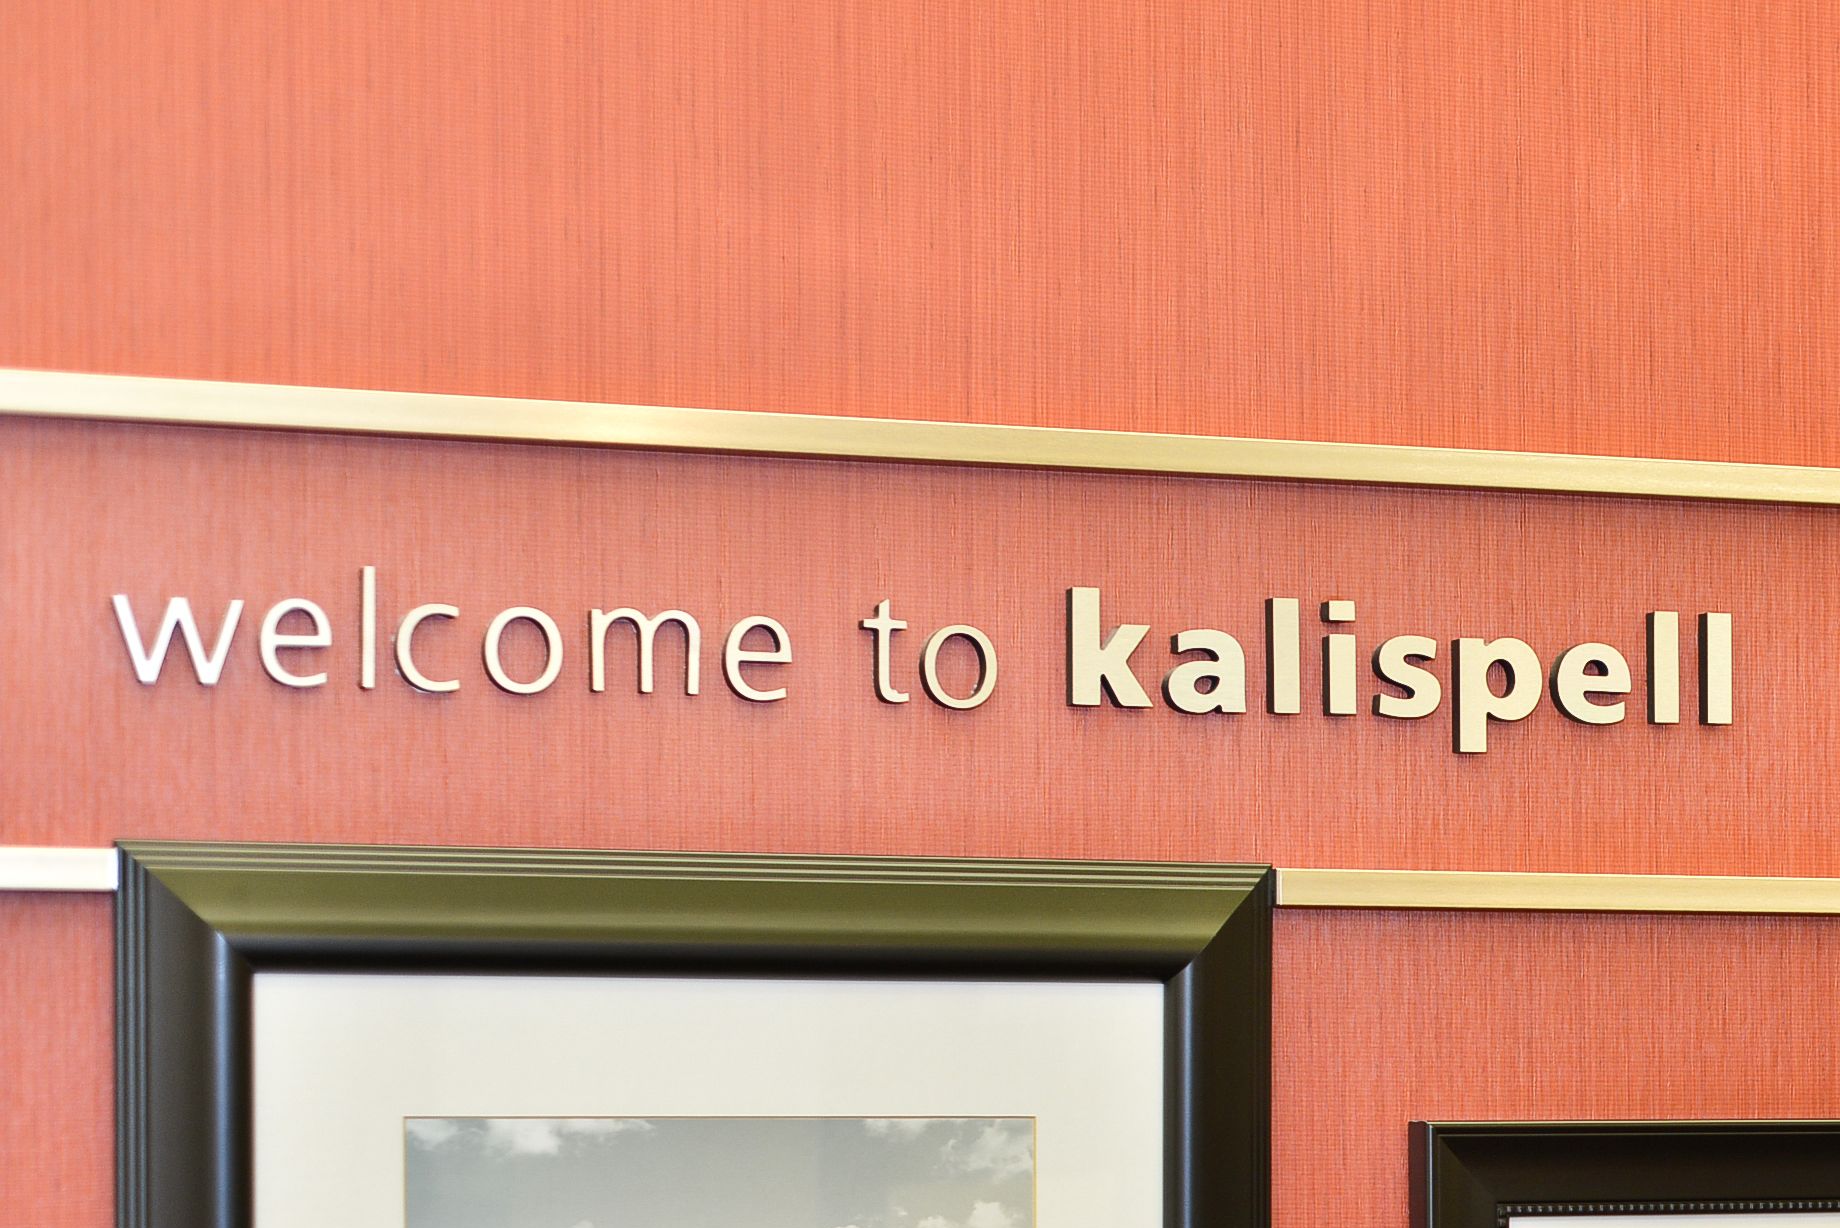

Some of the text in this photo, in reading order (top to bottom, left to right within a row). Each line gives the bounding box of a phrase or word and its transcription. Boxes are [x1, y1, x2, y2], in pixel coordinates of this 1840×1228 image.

[112, 565, 1733, 754] welcome to kalispell
